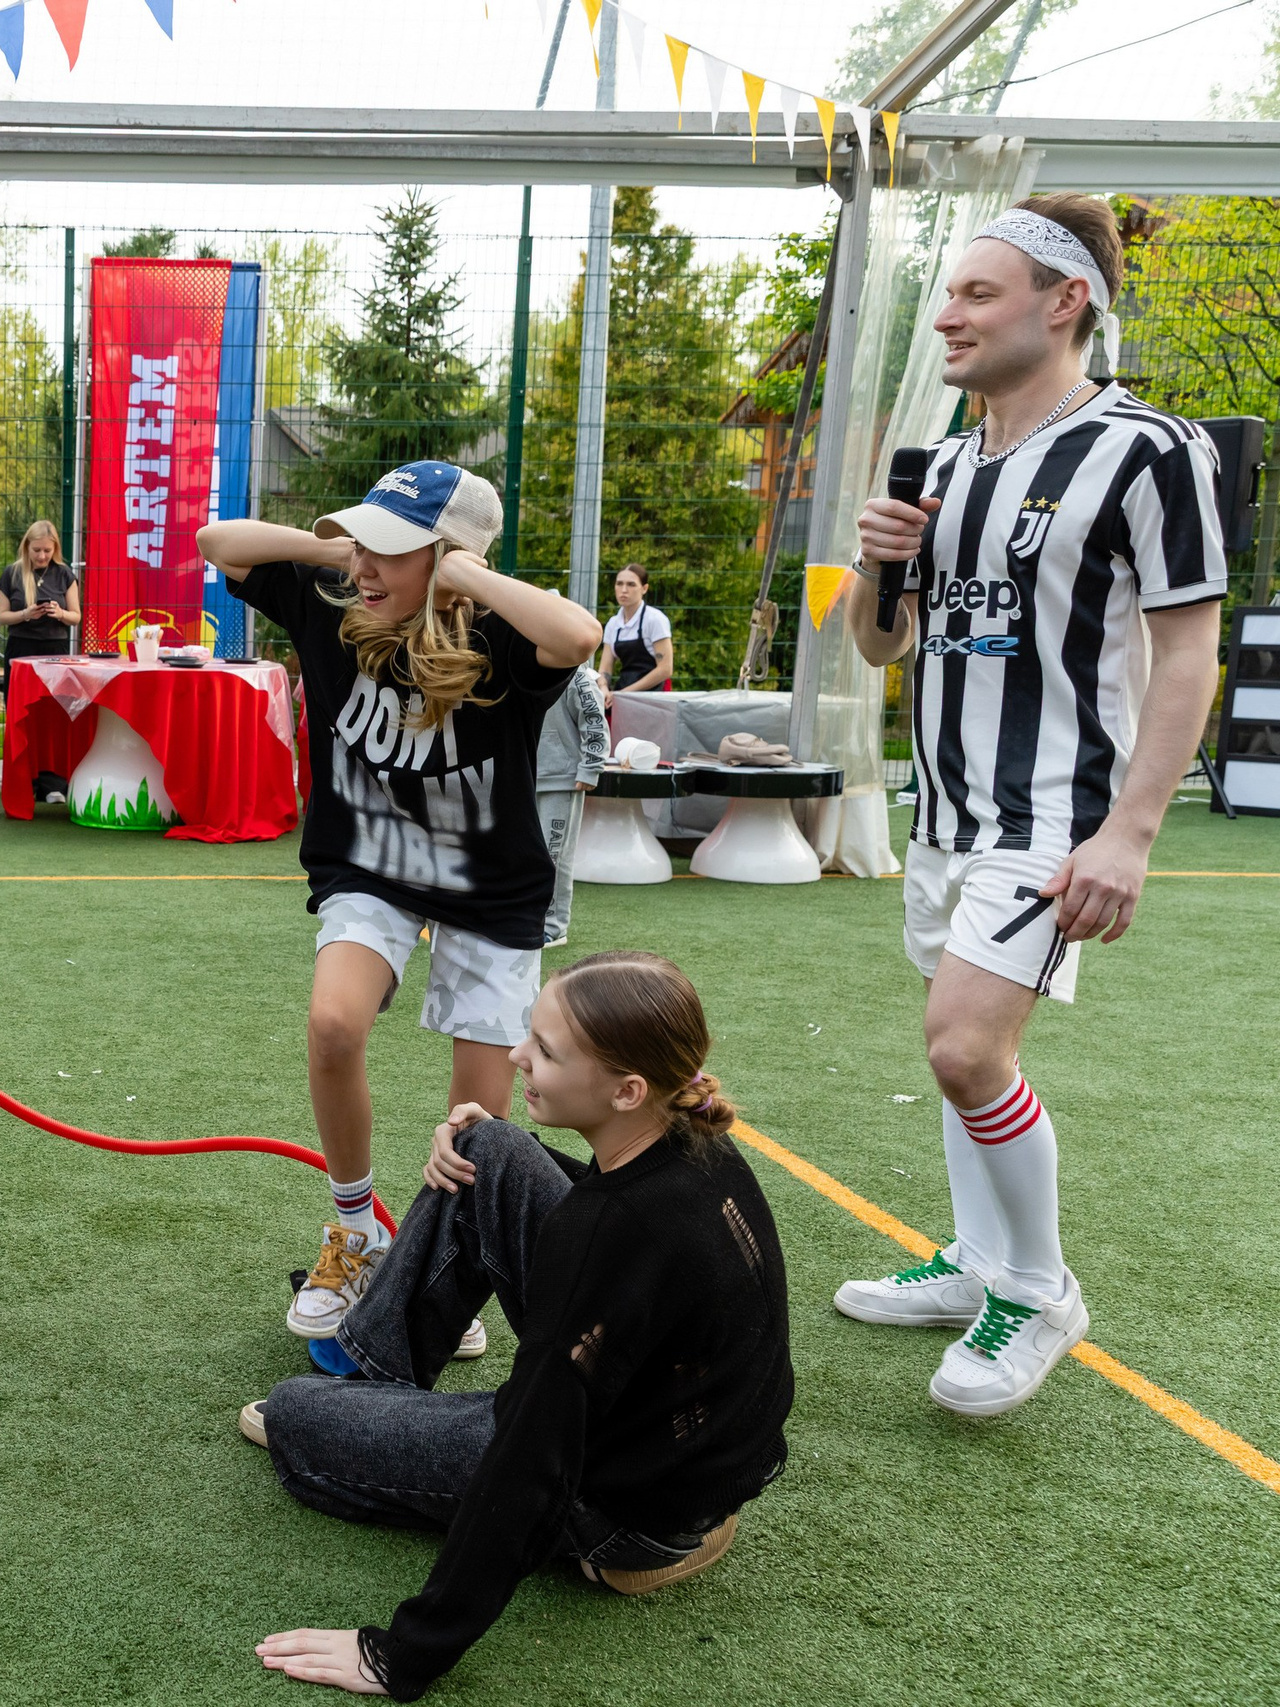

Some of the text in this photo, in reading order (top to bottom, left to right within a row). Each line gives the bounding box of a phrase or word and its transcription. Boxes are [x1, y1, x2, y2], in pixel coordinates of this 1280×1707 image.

[124, 354, 179, 569] ARTEM
[928, 569, 1019, 619] Jeep
[574, 671, 604, 764] ALENCIAGA
[423, 757, 495, 833] MY
[990, 885, 1056, 944] 7
